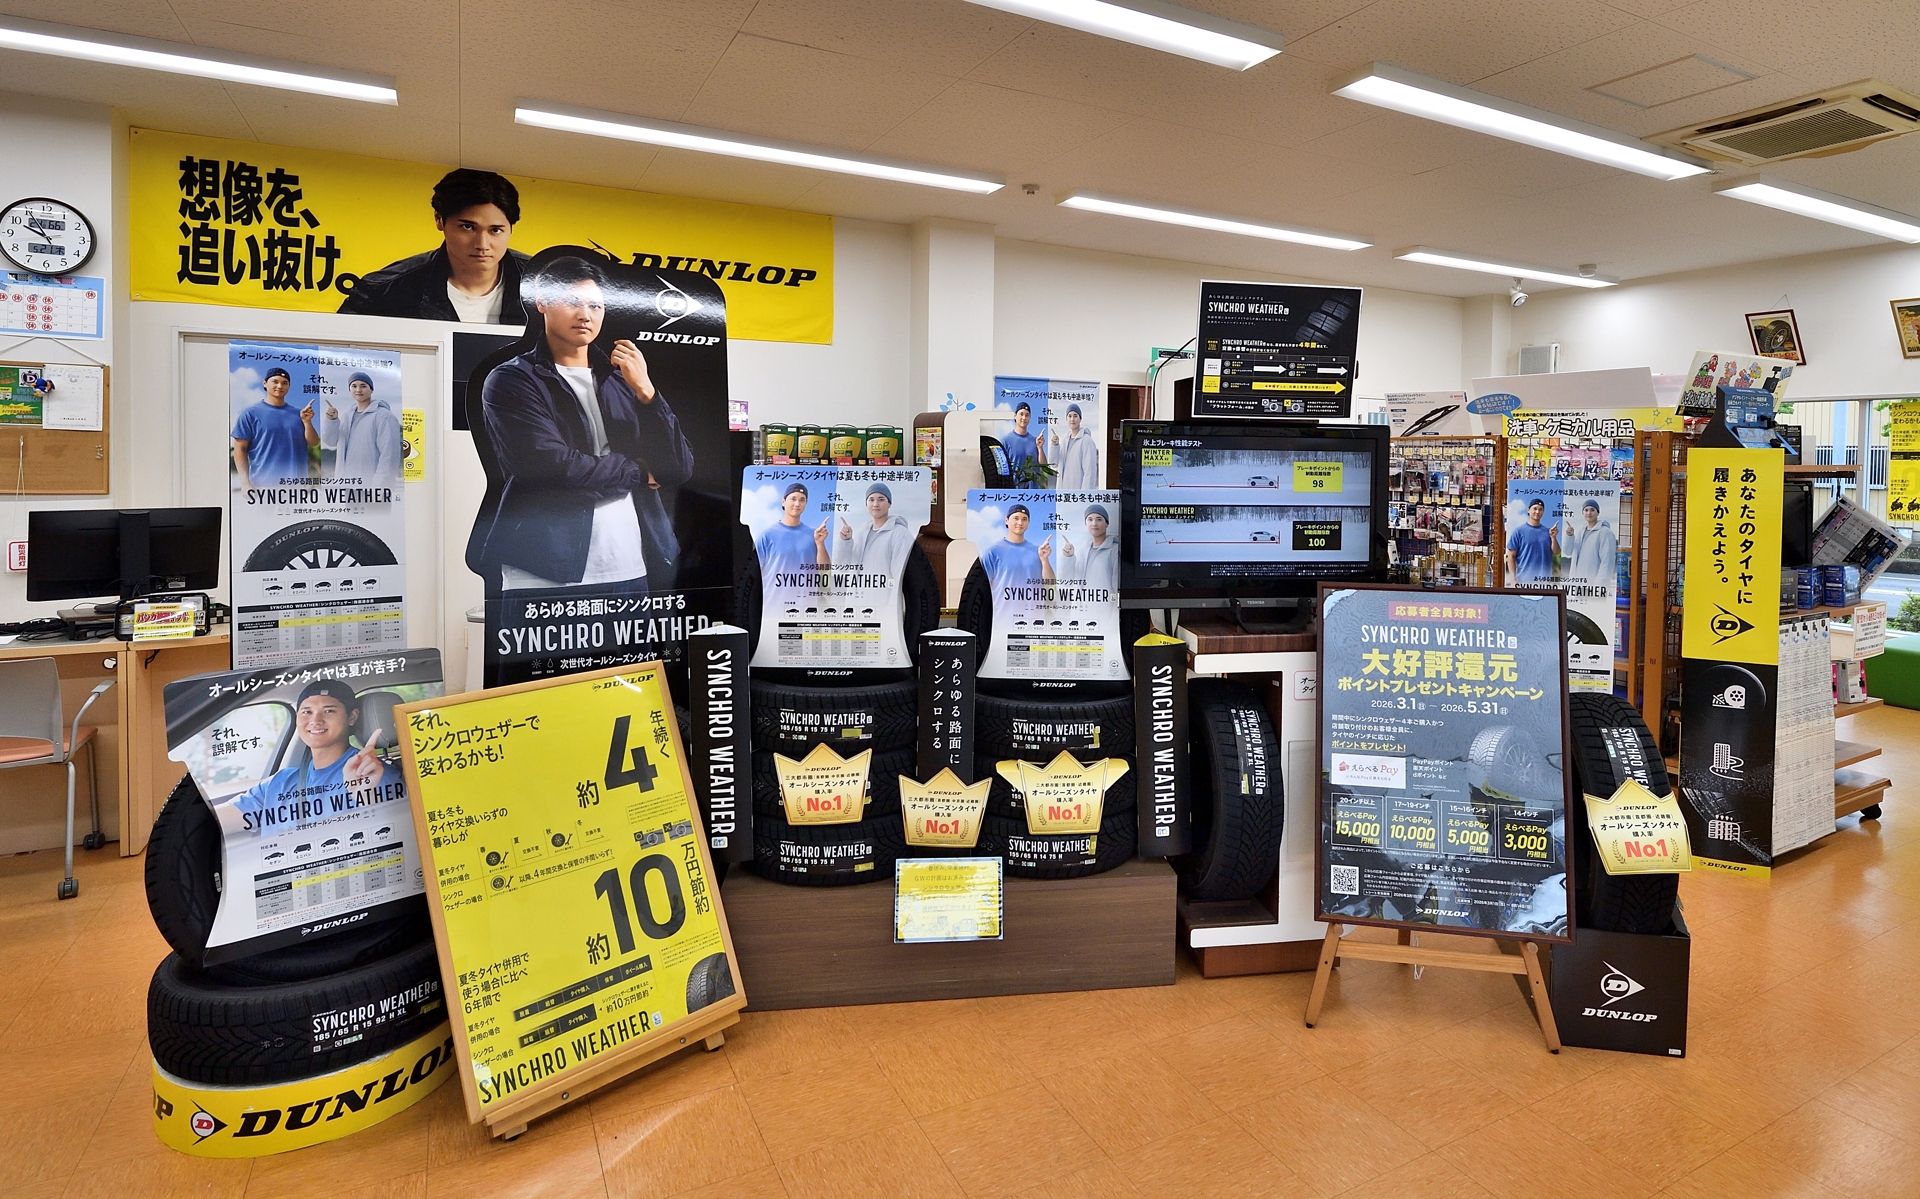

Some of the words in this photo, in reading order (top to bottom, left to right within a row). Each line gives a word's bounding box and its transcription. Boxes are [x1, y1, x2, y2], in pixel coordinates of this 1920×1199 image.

[178, 156, 320, 228] 想像を、
[7, 229, 14, 237] 9
[74, 222, 80, 230] 2
[12, 244, 19, 252] 8
[79, 236, 85, 244] 3
[178, 222, 360, 296] 追い抜け。
[630, 252, 817, 288] DUNLOP
[1208, 302, 1246, 313] SYNCHRO
[1248, 304, 1284, 314] WEATHER
[636, 331, 720, 346] DUNLOP
[310, 375, 328, 384] それ、
[303, 384, 338, 396] 誤解です。
[1508, 418, 1636, 438] 洗車・ケミカル用品
[279, 477, 362, 485] あらゆる路面にシンクロする
[756, 471, 920, 482] オールシーズンタイヤは夏も冬も中途半端?
[1313, 480, 1324, 488] 98
[248, 488, 318, 504] SYNCHRO
[325, 488, 392, 503] WEATHER
[827, 493, 844, 501] それ、
[821, 503, 850, 512] 誤解です。
[1043, 522, 1071, 531] 誤解です。
[1048, 514, 1064, 522] それ、
[1712, 468, 1730, 584] 履きかえよう。
[276, 526, 319, 547] DUNLOP
[1308, 538, 1326, 546] 100
[1737, 468, 1757, 604] あなたのタイヤに
[776, 574, 828, 588] SYNCHRO
[834, 574, 886, 588] WEATHER
[1004, 588, 1054, 600] SYNCHRO
[1059, 588, 1108, 602] WEATHER
[524, 594, 686, 620] あらゆる路面にシンクロする
[1395, 606, 1482, 619] 応募者全員対象!
[498, 622, 604, 655] SYNCHRO
[1362, 625, 1429, 644] SYNCHRO
[1436, 628, 1506, 648] WEATHER
[560, 652, 657, 670] 次世代オールシーズンタイヤ
[1362, 649, 1518, 682] 大好評還元
[209, 658, 406, 698] オールシーズンタイヤは夏が苦手?
[602, 674, 654, 690] DUNLOP
[707, 650, 733, 738] SYNCHRO
[1338, 676, 1544, 700] ポイントプレゼントキャンペーン
[932, 658, 944, 749] シンクロする
[949, 658, 962, 764] あらゆる路面に
[1152, 666, 1174, 742] SYNCHRO
[410, 712, 451, 730] それ、
[1012, 722, 1052, 735] SYNCHRO
[1056, 723, 1094, 736] WEATHER
[1245, 710, 1262, 744] SYNCHRO
[212, 727, 240, 738] それ、
[414, 716, 540, 754] シンクロウェザーで
[649, 709, 670, 758] 年続く
[1332, 732, 1396, 741] タイヤのインチに応じた
[212, 736, 264, 757] 誤解です。
[604, 714, 658, 793] 4
[1332, 740, 1406, 751] ポイントをプレゼント!
[418, 744, 504, 778] 変わるかも!
[1253, 747, 1266, 788] WEATHER
[278, 776, 370, 802] あらゆる路面にシンクロする
[710, 745, 736, 834] WEATHER
[789, 780, 858, 788] オールシーズンタイヤ
[1032, 788, 1098, 796] オールシーズンタイヤ
[1154, 748, 1176, 824] WEATHER
[576, 780, 600, 809] 約
[806, 795, 842, 812] No.1
[1340, 797, 1374, 806] 20インチ以上
[242, 801, 323, 830] SYNCHRO
[330, 782, 404, 812] WEATHER
[427, 804, 464, 824] 夏も冬も
[910, 804, 976, 812] オールシーズンタイヤ
[1048, 804, 1082, 820] No.1
[1514, 810, 1538, 818] 14インチ
[430, 808, 508, 836] タイヤ交換いらずの
[1337, 811, 1376, 821] えらべるPay
[1392, 814, 1432, 824] えらべるPay
[1448, 818, 1490, 830] えらべるPay
[926, 820, 959, 834] No.1
[1335, 820, 1380, 838] 15,000
[1390, 824, 1436, 843] 10,000
[1504, 823, 1548, 834] えらべるPay
[1600, 822, 1679, 830] オールシーズンタイヤ
[432, 830, 468, 850] 暮らしが
[1009, 839, 1048, 852] SYNCHRO
[1052, 840, 1090, 852] WEATHER
[1360, 837, 1380, 845] 円相当
[1416, 841, 1436, 850] 円相当
[1448, 829, 1489, 848] 5,000
[1504, 833, 1548, 852] 3,000
[780, 844, 820, 858] SYNCHRO
[824, 844, 865, 858] WEATHER
[1625, 839, 1668, 858] No.1
[438, 864, 465, 876] 夏冬タイヤ
[1410, 862, 1471, 874] ご応募はこちらから
[1706, 861, 1746, 872] DUNLOP
[440, 874, 470, 887] 併用の場合
[680, 840, 710, 914] 万円節約
[443, 890, 464, 902] シンクロ
[444, 894, 483, 912] ウェザーの場合
[594, 854, 686, 954] 10
[312, 912, 368, 933] DUNLOP
[1423, 909, 1468, 918] DUNLOP
[586, 932, 611, 966] 約
[458, 952, 530, 987] 夏冬タイヤ併用で
[462, 968, 528, 1000] 使う場合に比べ
[312, 1003, 376, 1034] SYNCHRO
[380, 980, 430, 1014] WEATHER
[464, 992, 501, 1014] 6年間で
[606, 990, 649, 1014] 約10万円節約
[353, 1024, 360, 1032] R
[362, 1020, 372, 1030] 15
[376, 1016, 386, 1026] 92
[388, 1012, 396, 1020] H
[397, 1008, 406, 1016] XL
[1582, 1008, 1658, 1022] DUNLOP
[468, 1016, 496, 1034] 夏冬タイヤ
[470, 1026, 500, 1044] 併用の場合
[473, 1046, 494, 1060] シンクロ
[479, 1046, 566, 1104] SYNCHRO
[572, 1010, 650, 1062] WEATHER
